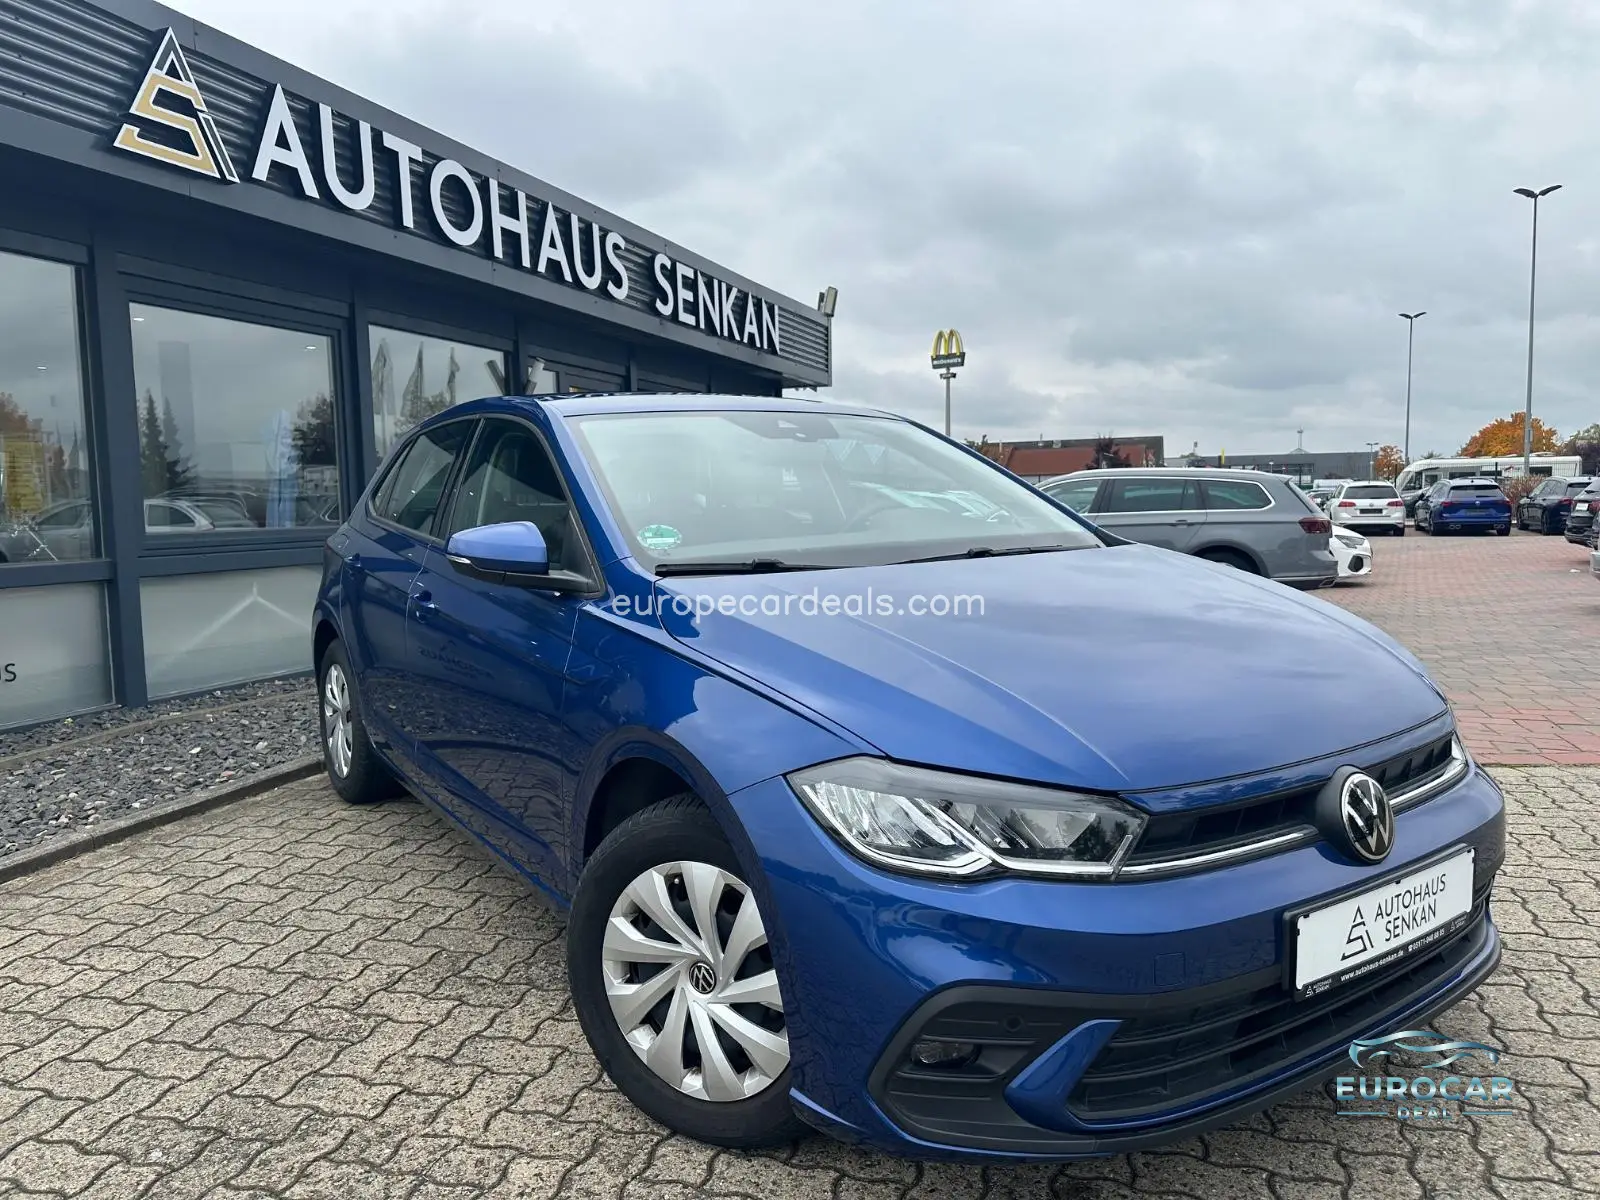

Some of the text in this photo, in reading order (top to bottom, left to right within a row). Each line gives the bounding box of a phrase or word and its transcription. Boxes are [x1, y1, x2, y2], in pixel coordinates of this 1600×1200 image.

[251, 83, 629, 300] AUTOHAUS
[654, 253, 781, 355] SENKAN
[1374, 873, 1446, 922] AUTOHAUS
[1384, 898, 1437, 942] SENKAN
